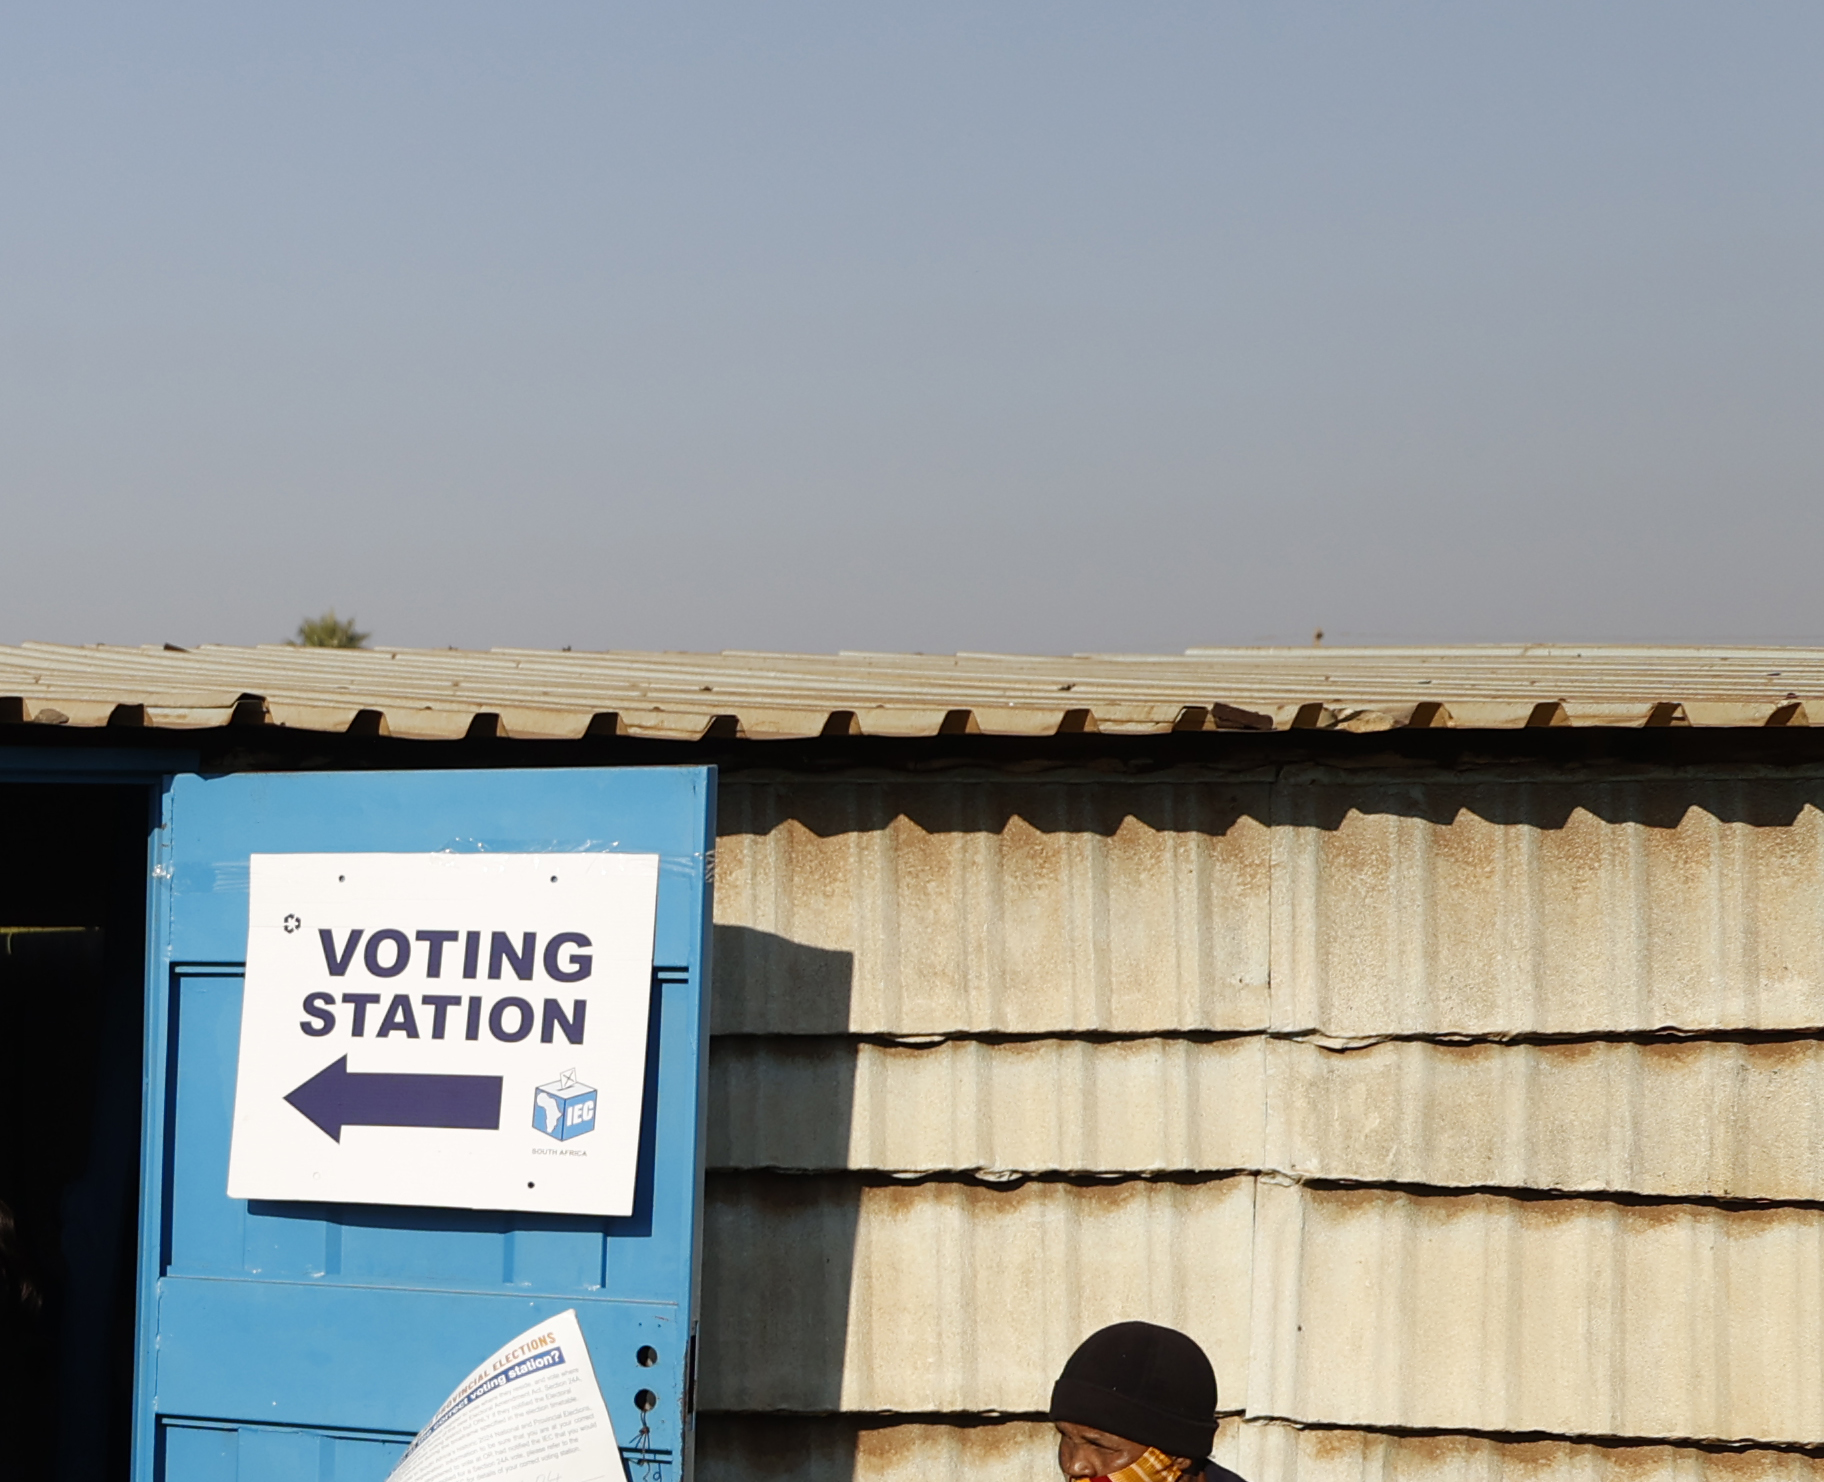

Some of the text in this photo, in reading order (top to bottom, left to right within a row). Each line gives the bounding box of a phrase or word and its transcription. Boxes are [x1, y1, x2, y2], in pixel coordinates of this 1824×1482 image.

[317, 928, 594, 983] VOTING
[299, 991, 588, 1045] STATION
[566, 1100, 594, 1127] IEC
[470, 1375, 506, 1400] voting
[508, 1350, 561, 1379] station?
[492, 1331, 557, 1373] ELECTIONS
